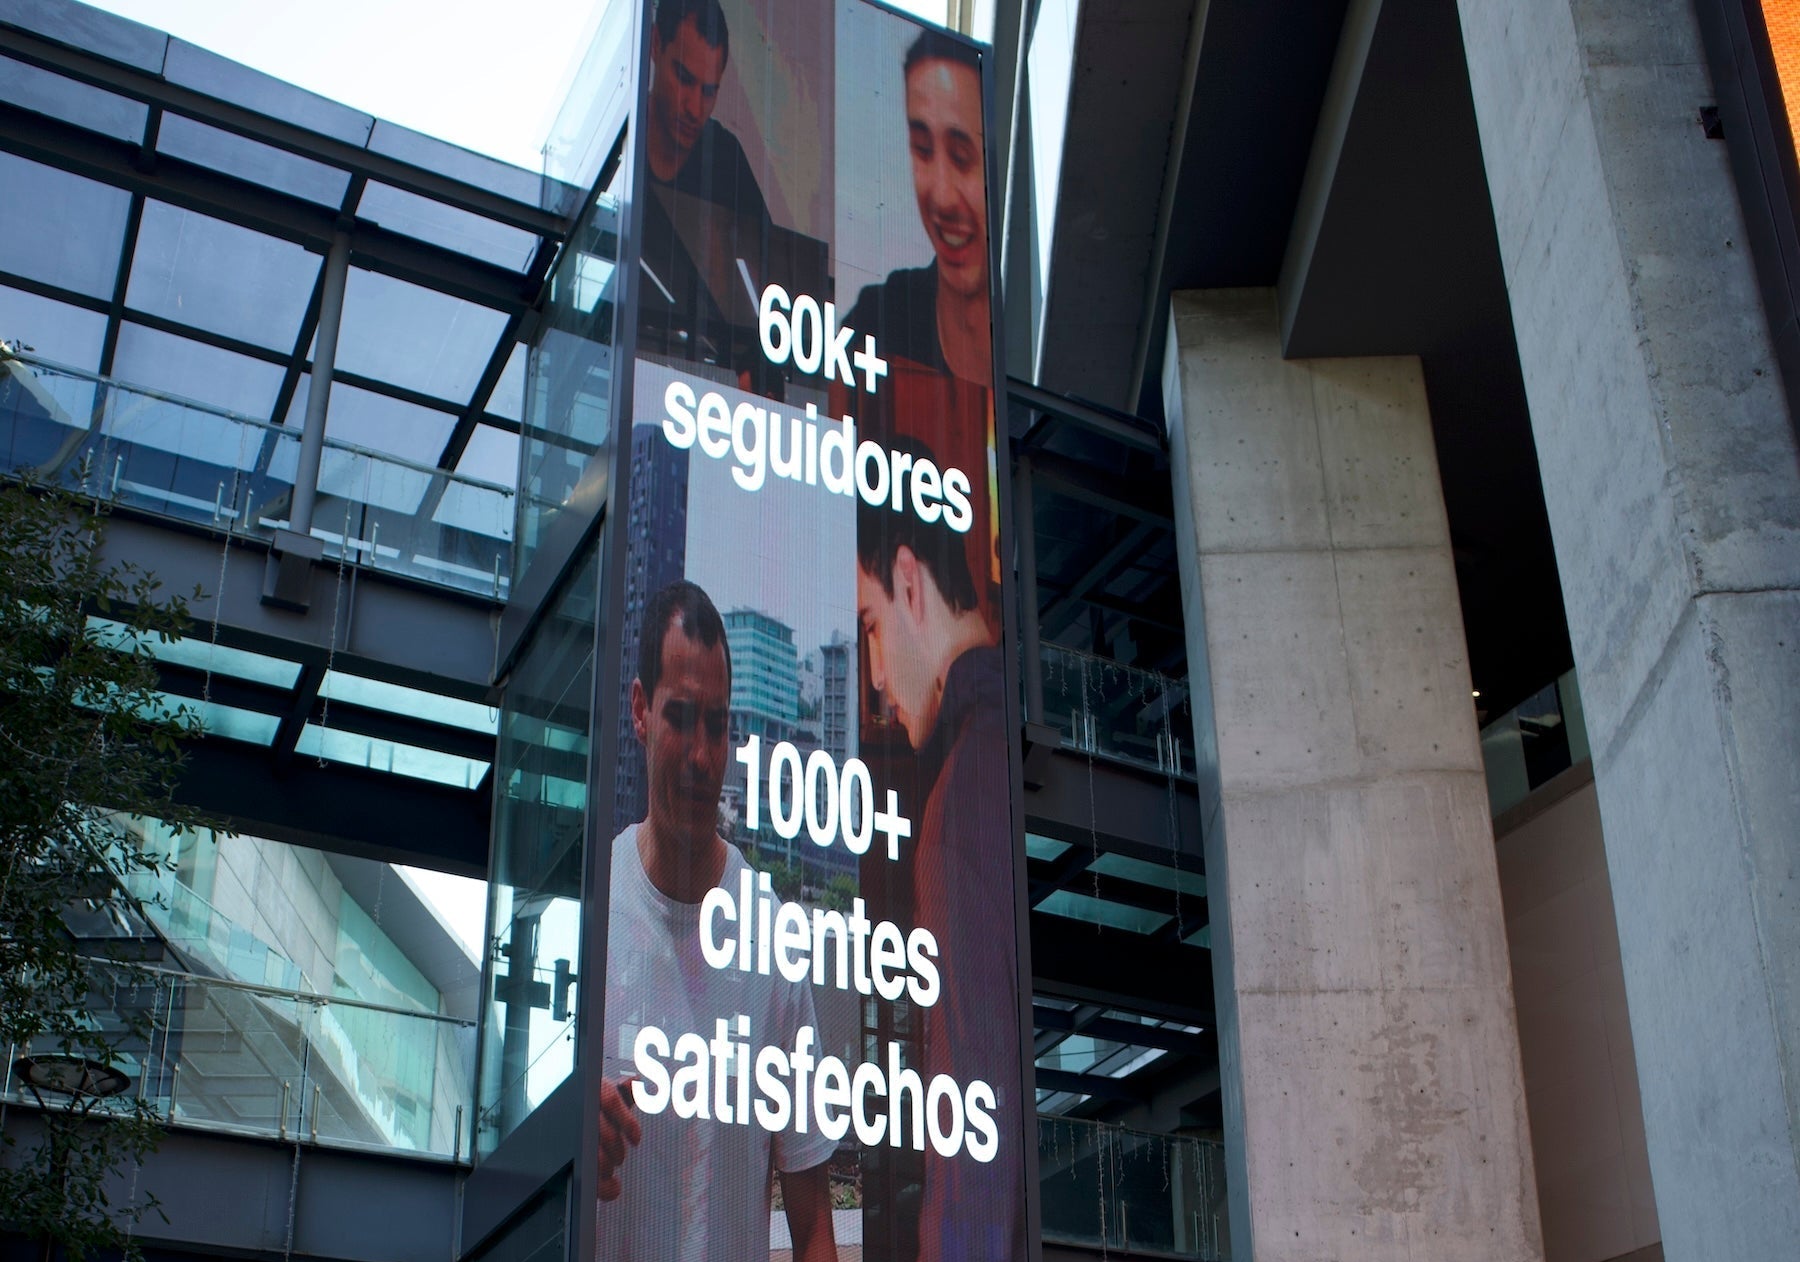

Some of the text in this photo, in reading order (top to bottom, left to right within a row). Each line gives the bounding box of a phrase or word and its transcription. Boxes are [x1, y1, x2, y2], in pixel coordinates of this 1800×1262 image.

[758, 283, 888, 392] 60k+
[661, 380, 973, 532] seguidores
[735, 733, 912, 861] 1000+
[698, 867, 941, 1008] clientes
[630, 1013, 999, 1163] satisfechos
